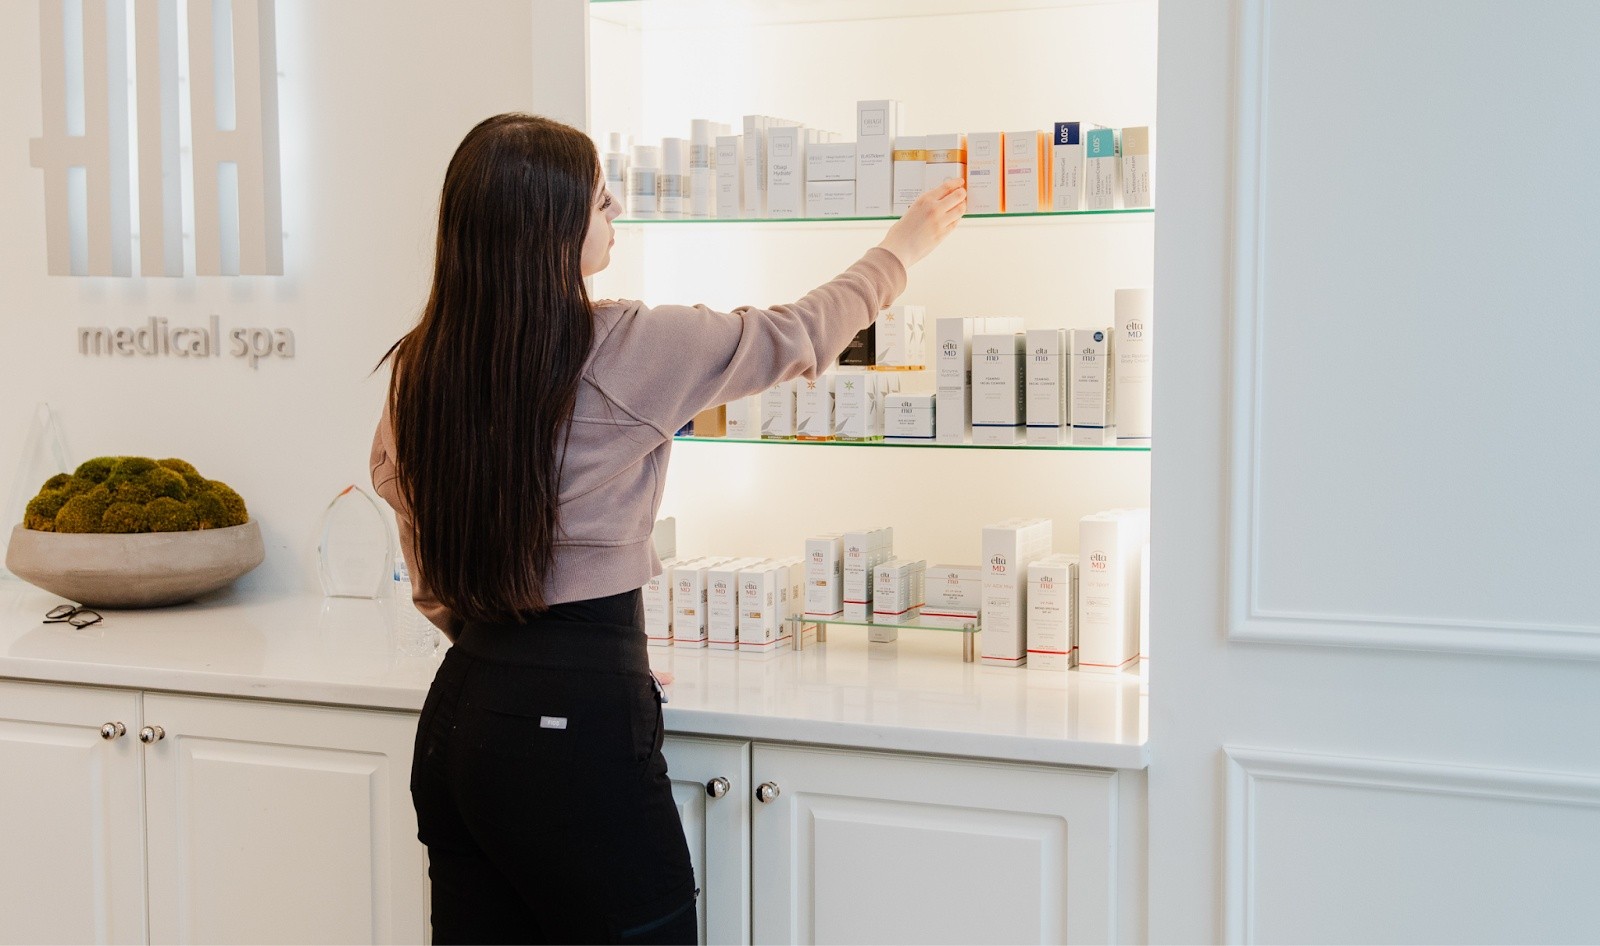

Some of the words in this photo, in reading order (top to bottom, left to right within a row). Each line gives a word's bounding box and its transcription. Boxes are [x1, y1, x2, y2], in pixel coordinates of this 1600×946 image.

[1126, 322, 1143, 330] elta
[78, 314, 220, 358] medical
[228, 326, 296, 370] spa
[991, 556, 1006, 565] elta
